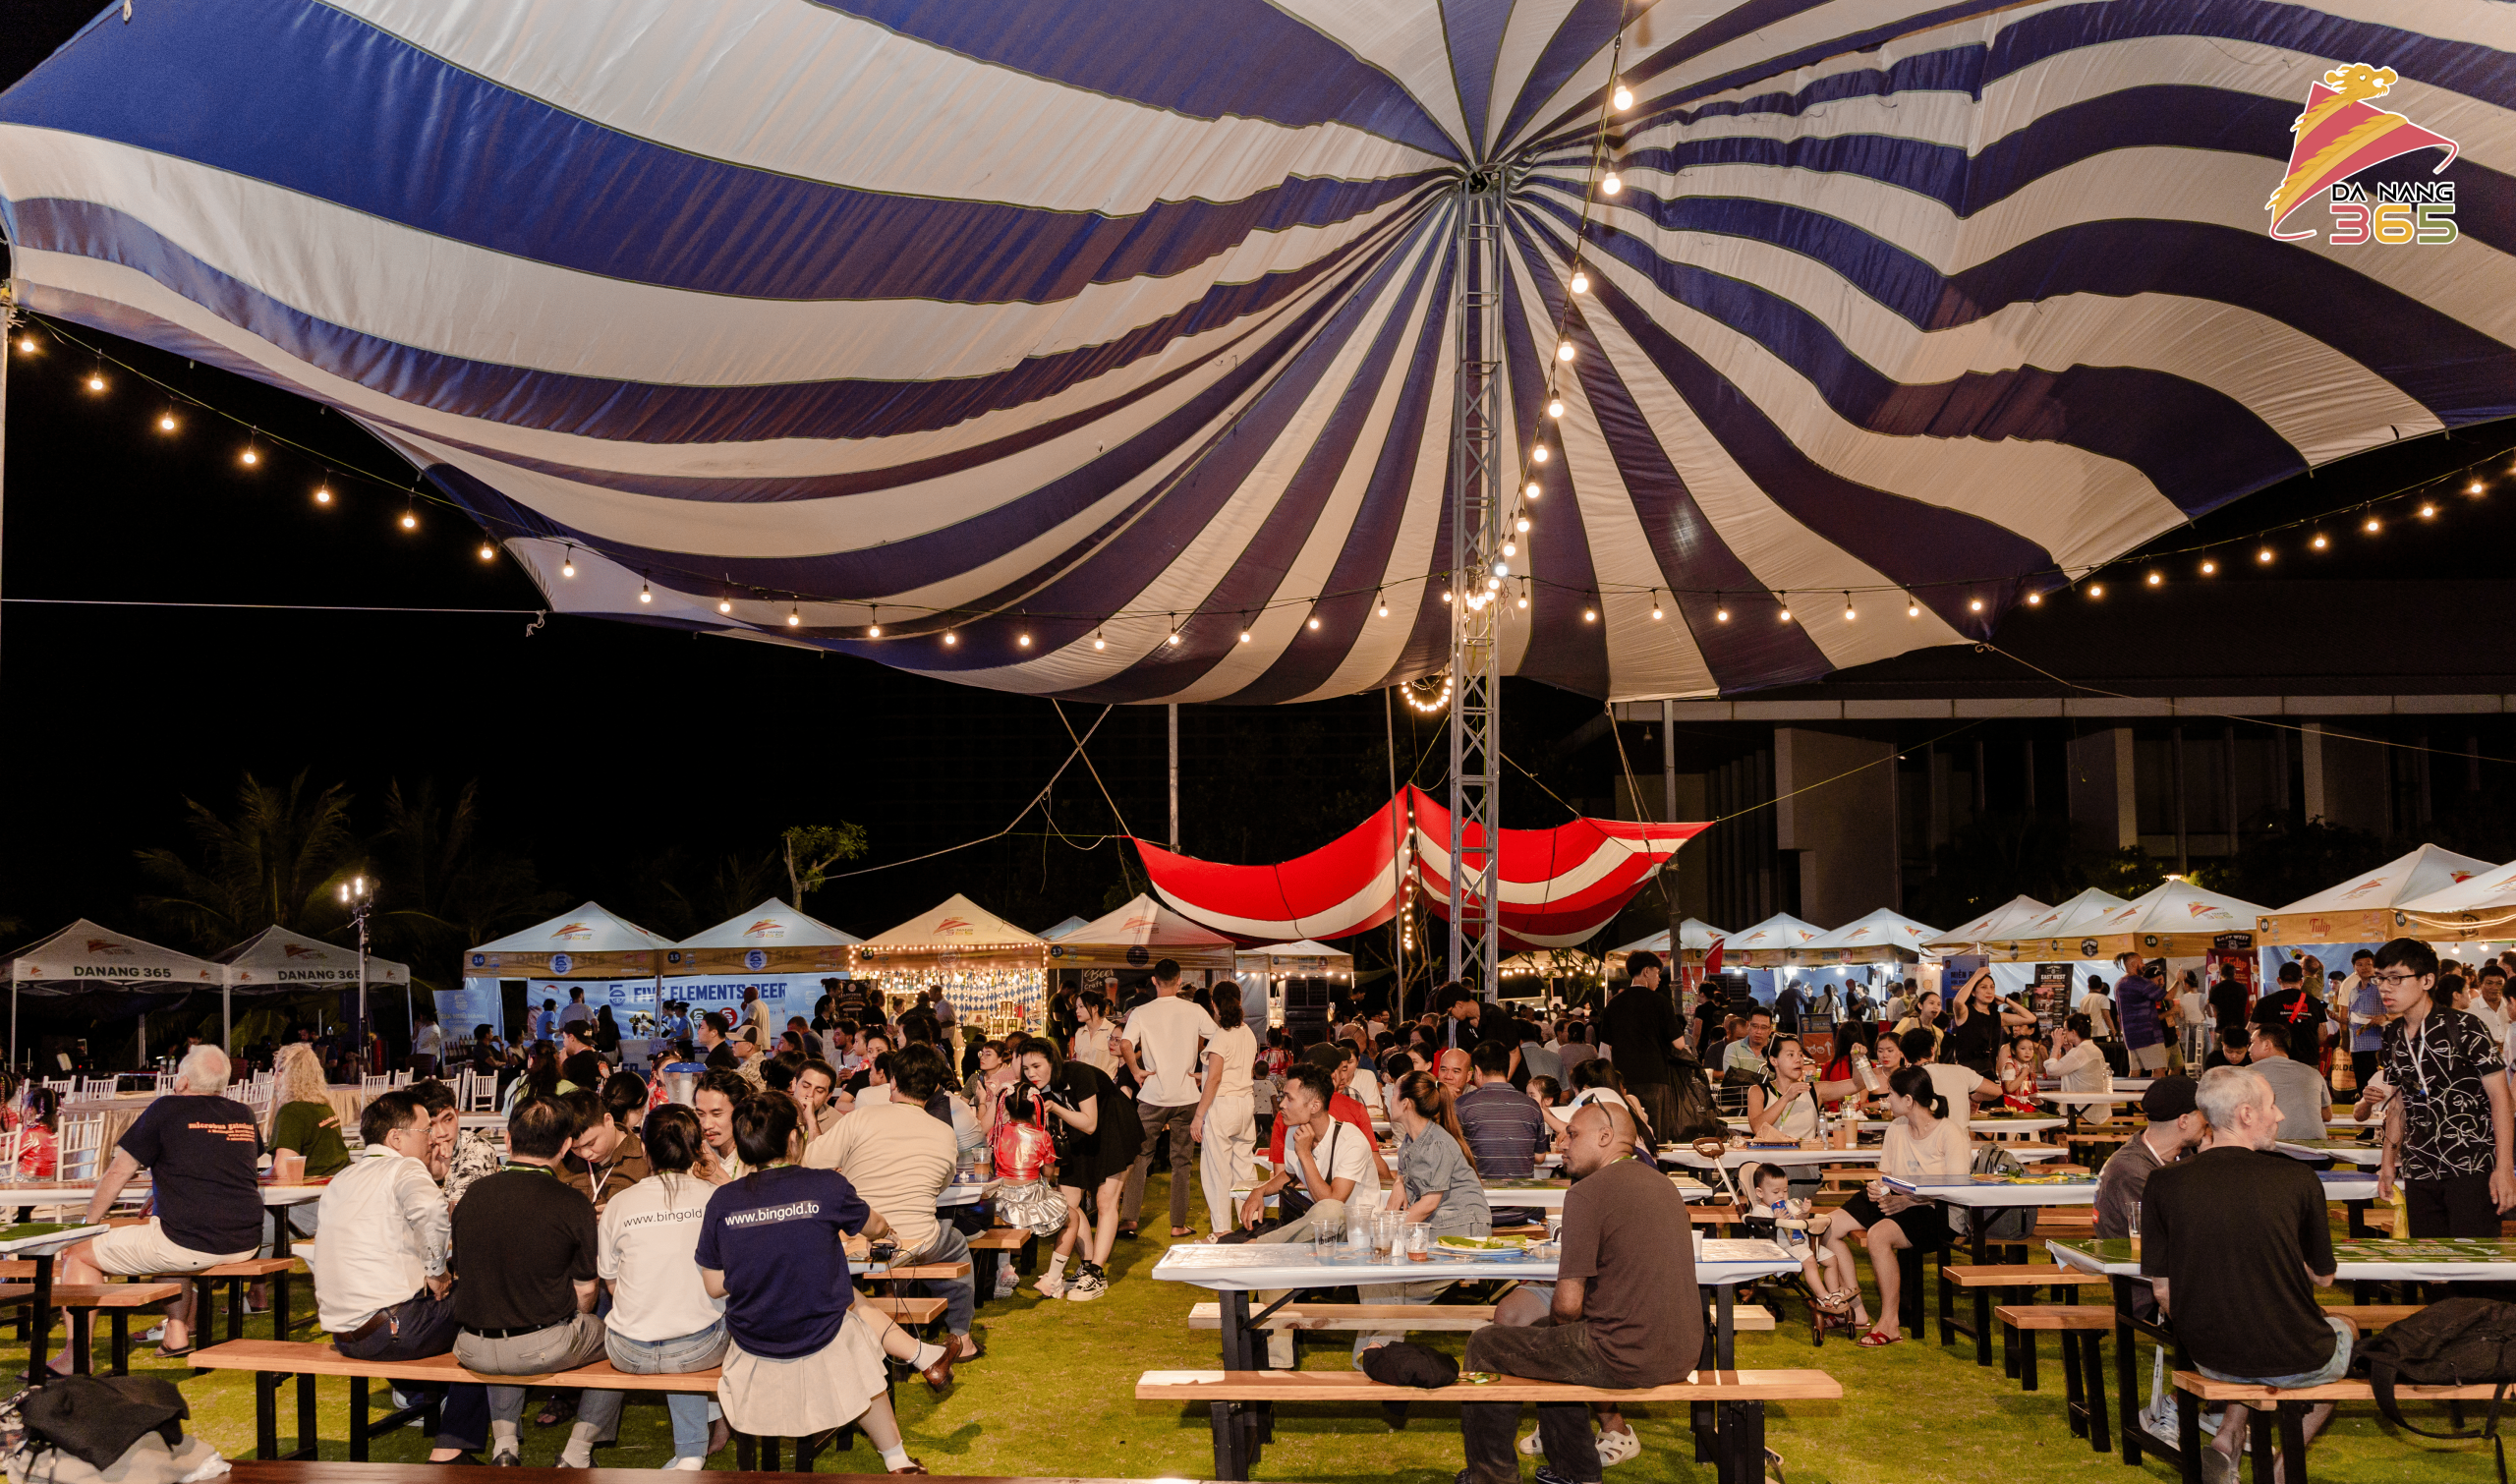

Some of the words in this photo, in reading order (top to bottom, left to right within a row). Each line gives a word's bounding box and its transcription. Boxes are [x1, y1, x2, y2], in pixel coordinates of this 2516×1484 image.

[2310, 919, 2330, 937] Tulip
[74, 966, 140, 977] DANANG
[143, 967, 172, 978] 365
[278, 970, 335, 981] DANANG
[670, 984, 746, 1000] ELEMENTS
[623, 1208, 703, 1227] www.bingold
[724, 1202, 820, 1227] www.bingold.to
